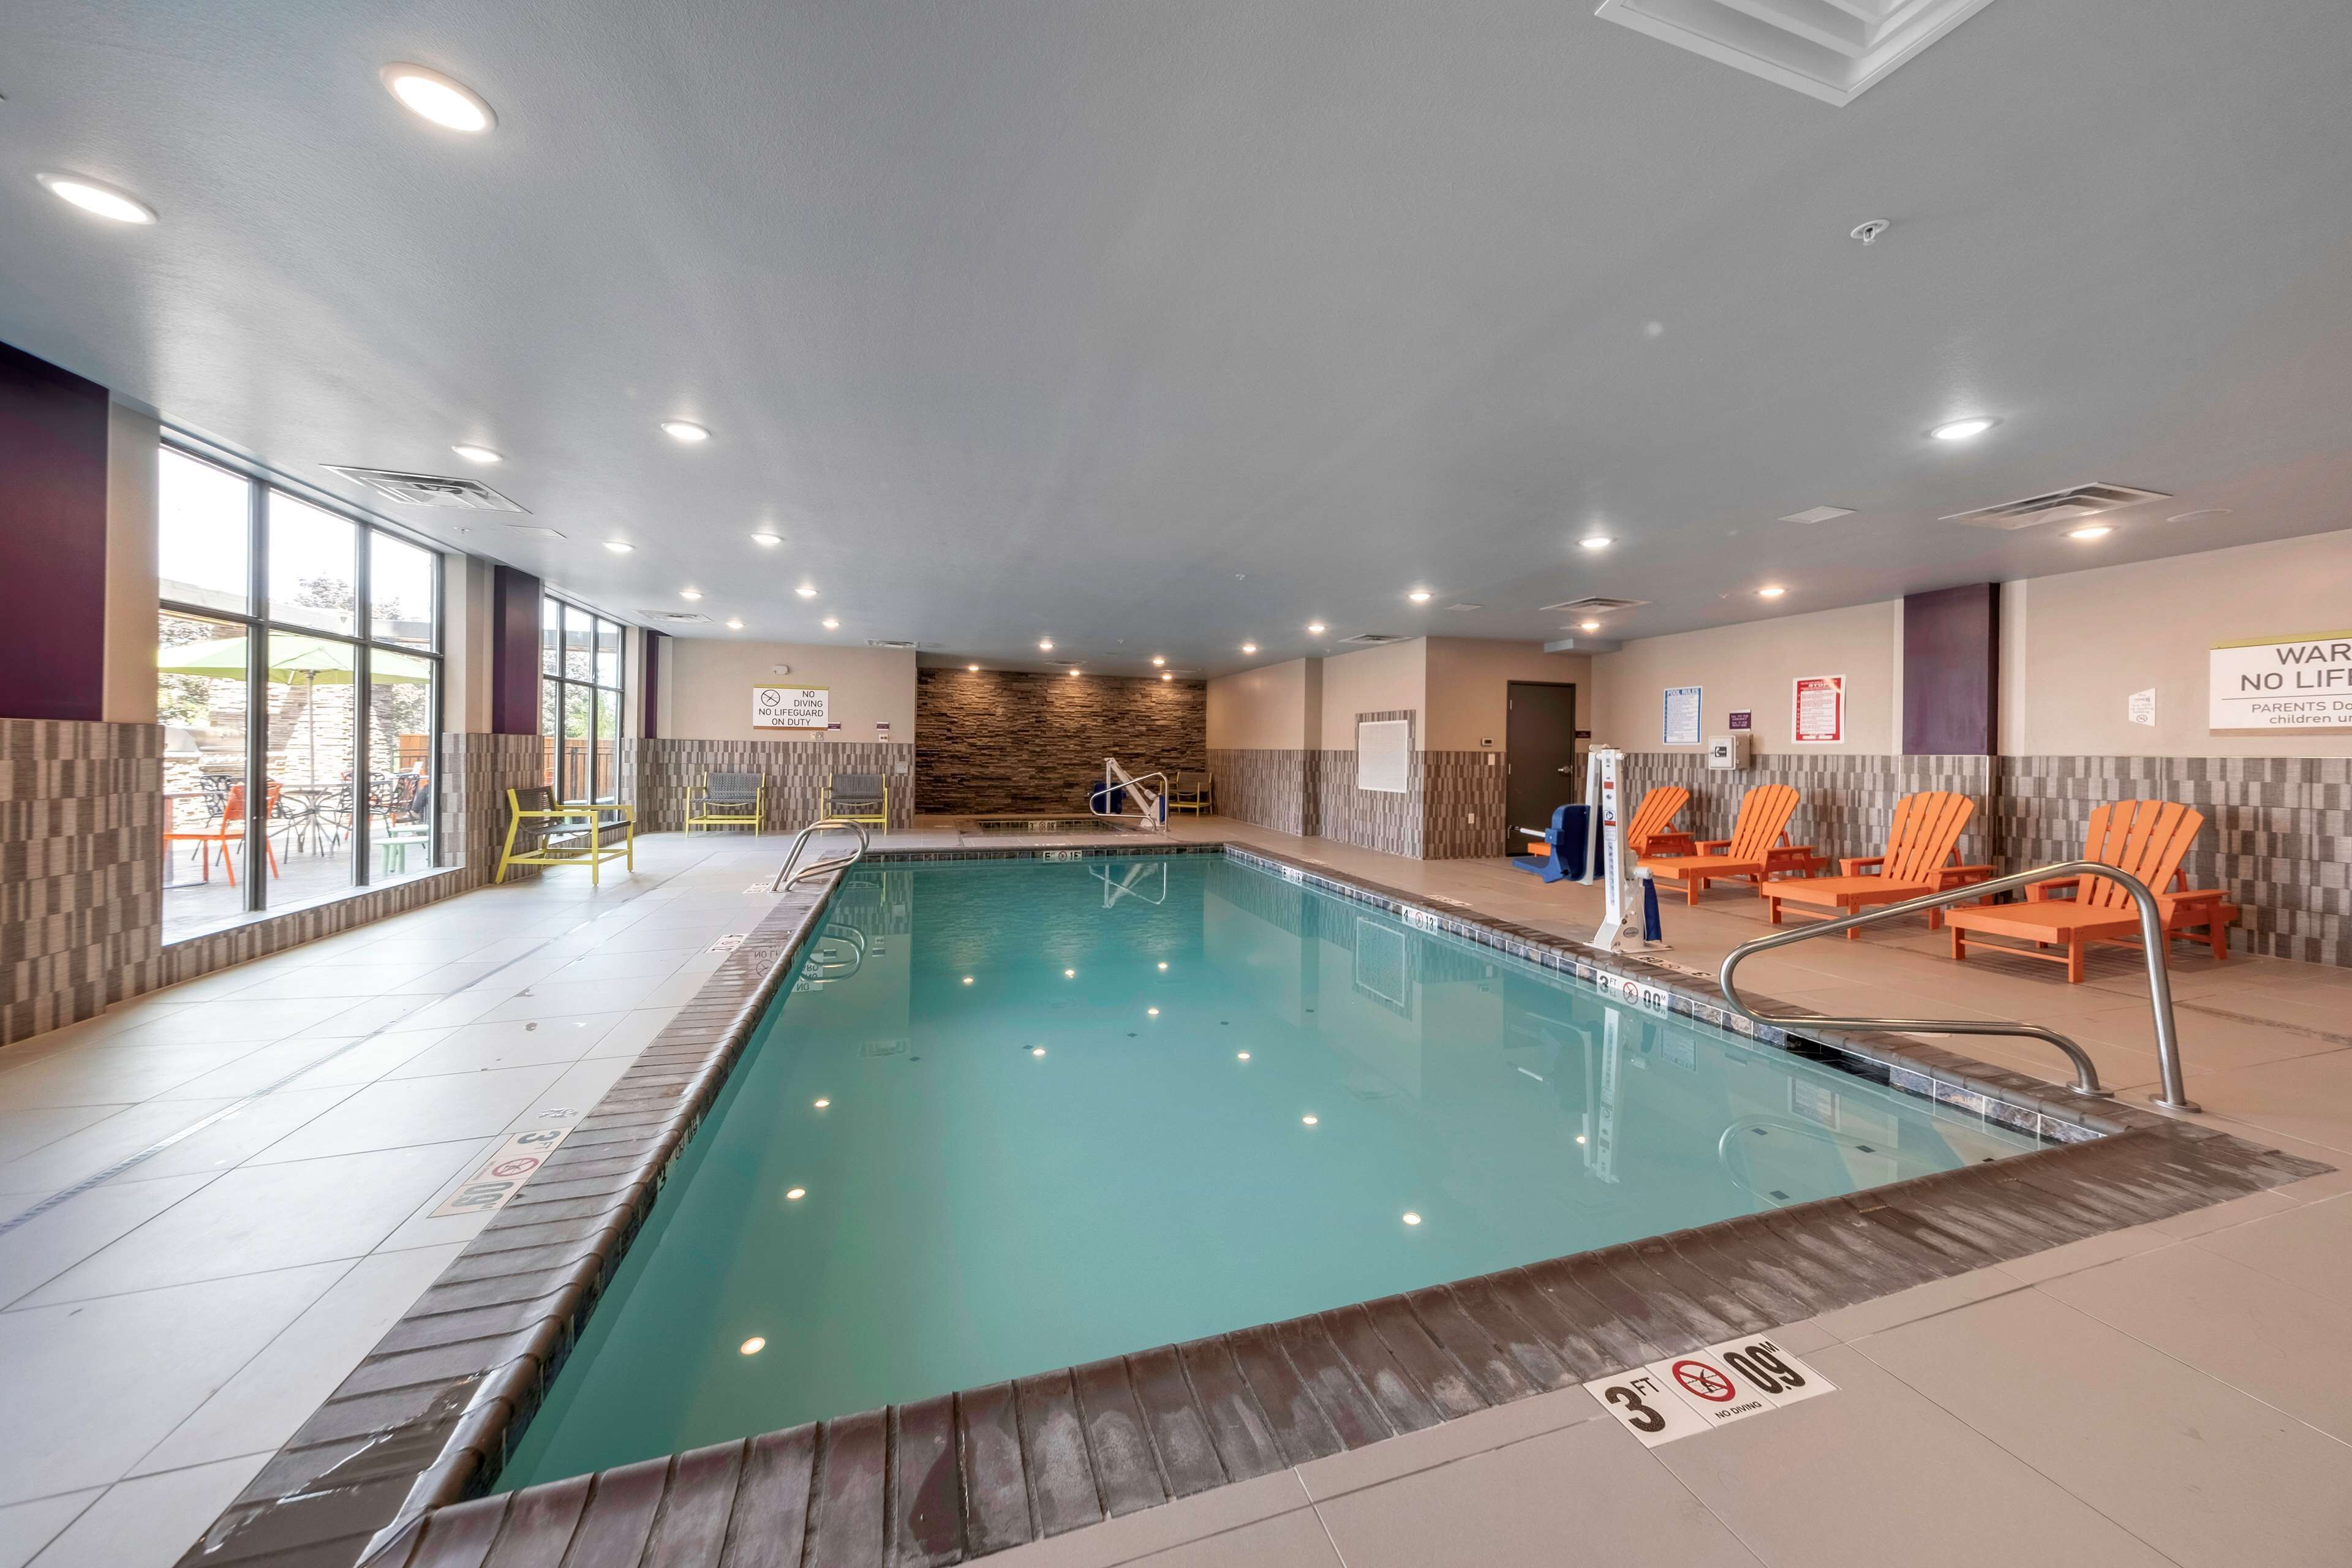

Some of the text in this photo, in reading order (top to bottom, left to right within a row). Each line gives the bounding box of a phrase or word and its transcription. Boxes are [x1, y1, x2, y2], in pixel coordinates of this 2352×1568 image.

[2276, 643, 2352, 665] WAR
[2241, 673, 2283, 691] NO
[2252, 701, 2326, 713] PARENTS
[2269, 715, 2331, 724] children
[1759, 1341, 1779, 1353] M
[1605, 1377, 1666, 1432] 3 FT
[1714, 1401, 1762, 1419] NO DIVING
